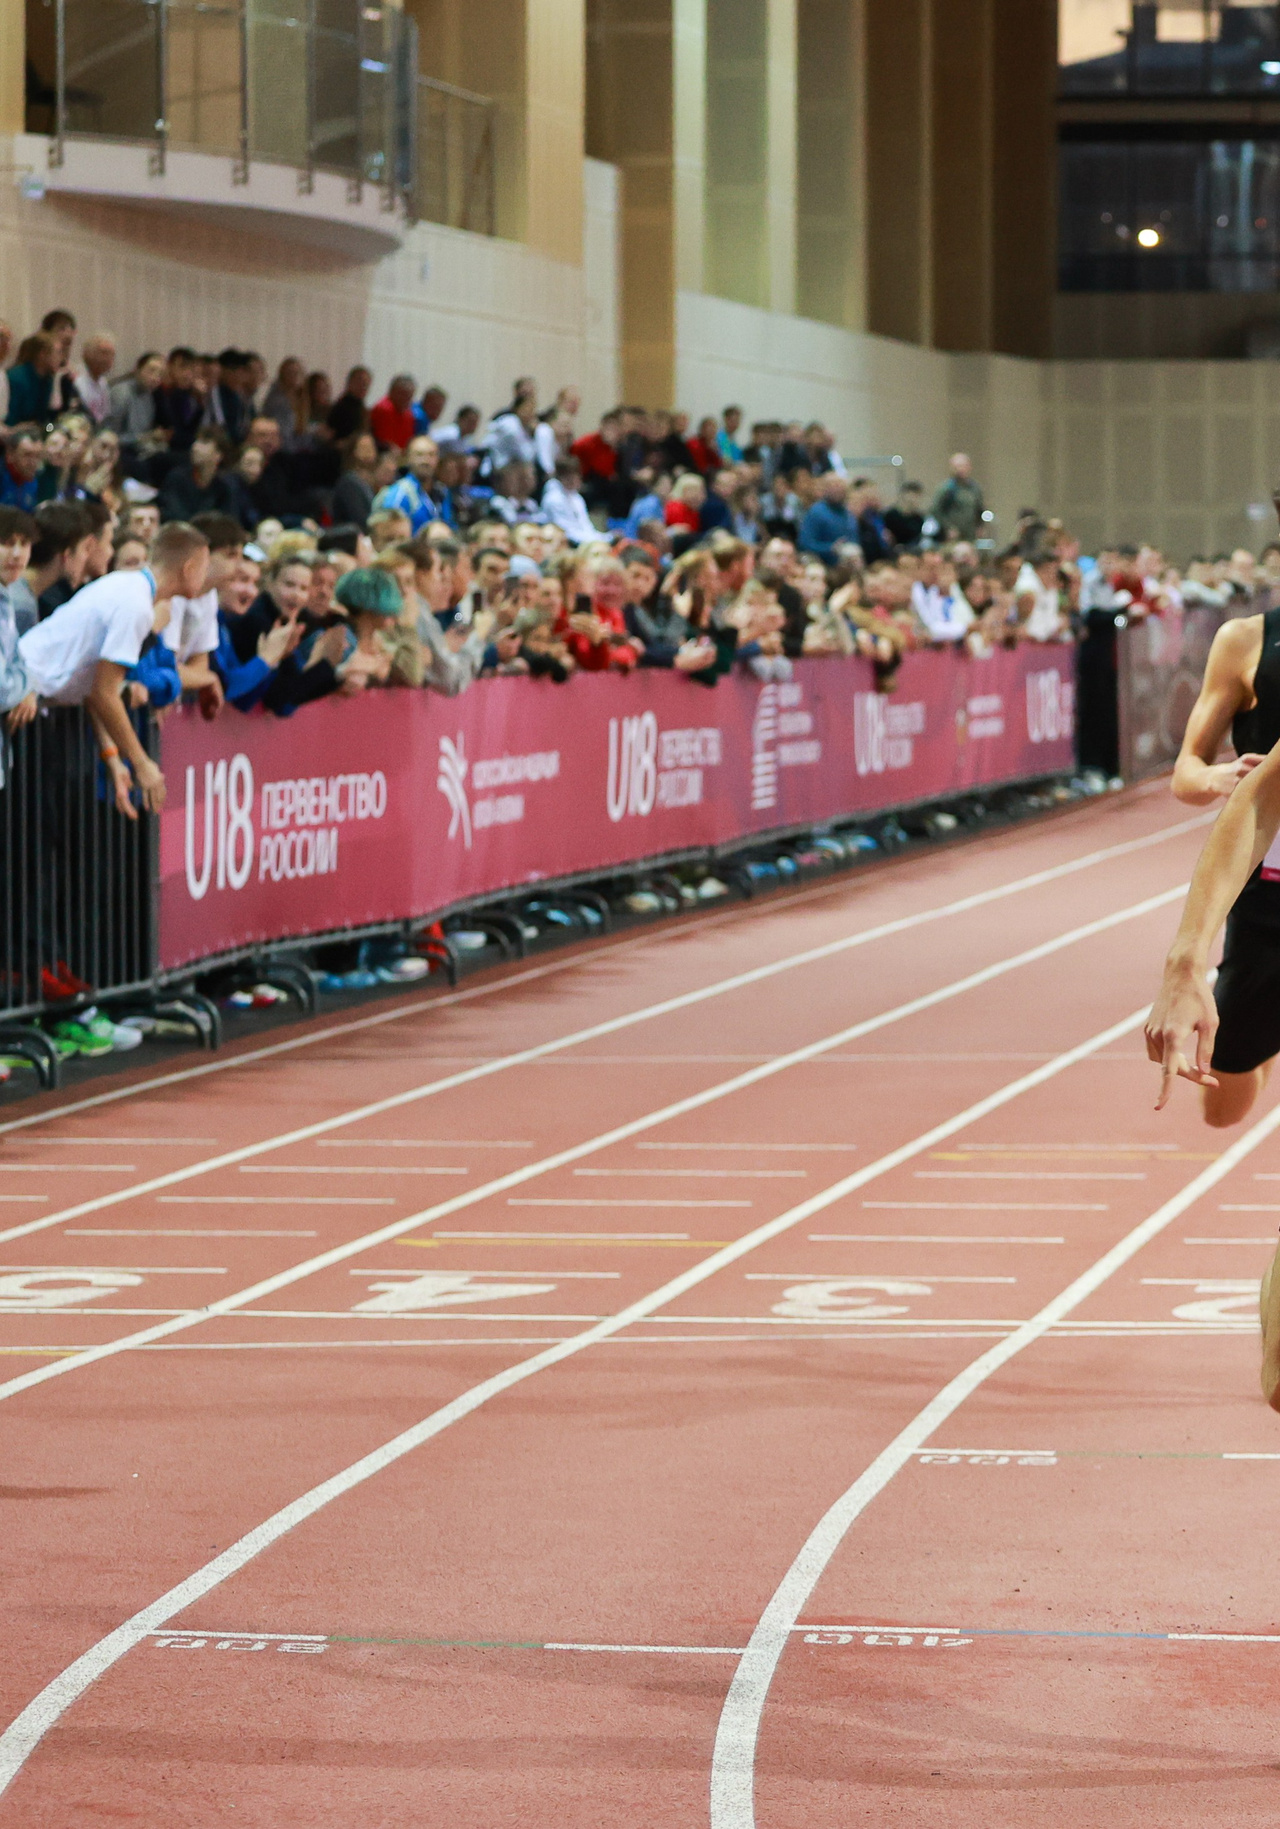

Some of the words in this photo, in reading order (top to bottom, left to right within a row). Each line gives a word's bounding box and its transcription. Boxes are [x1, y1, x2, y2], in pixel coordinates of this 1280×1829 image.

[261, 770, 388, 830] ПЕРВЕНСТВО
[607, 710, 658, 822] U18
[185, 752, 254, 900] U18
[258, 827, 339, 884] РОССИИ
